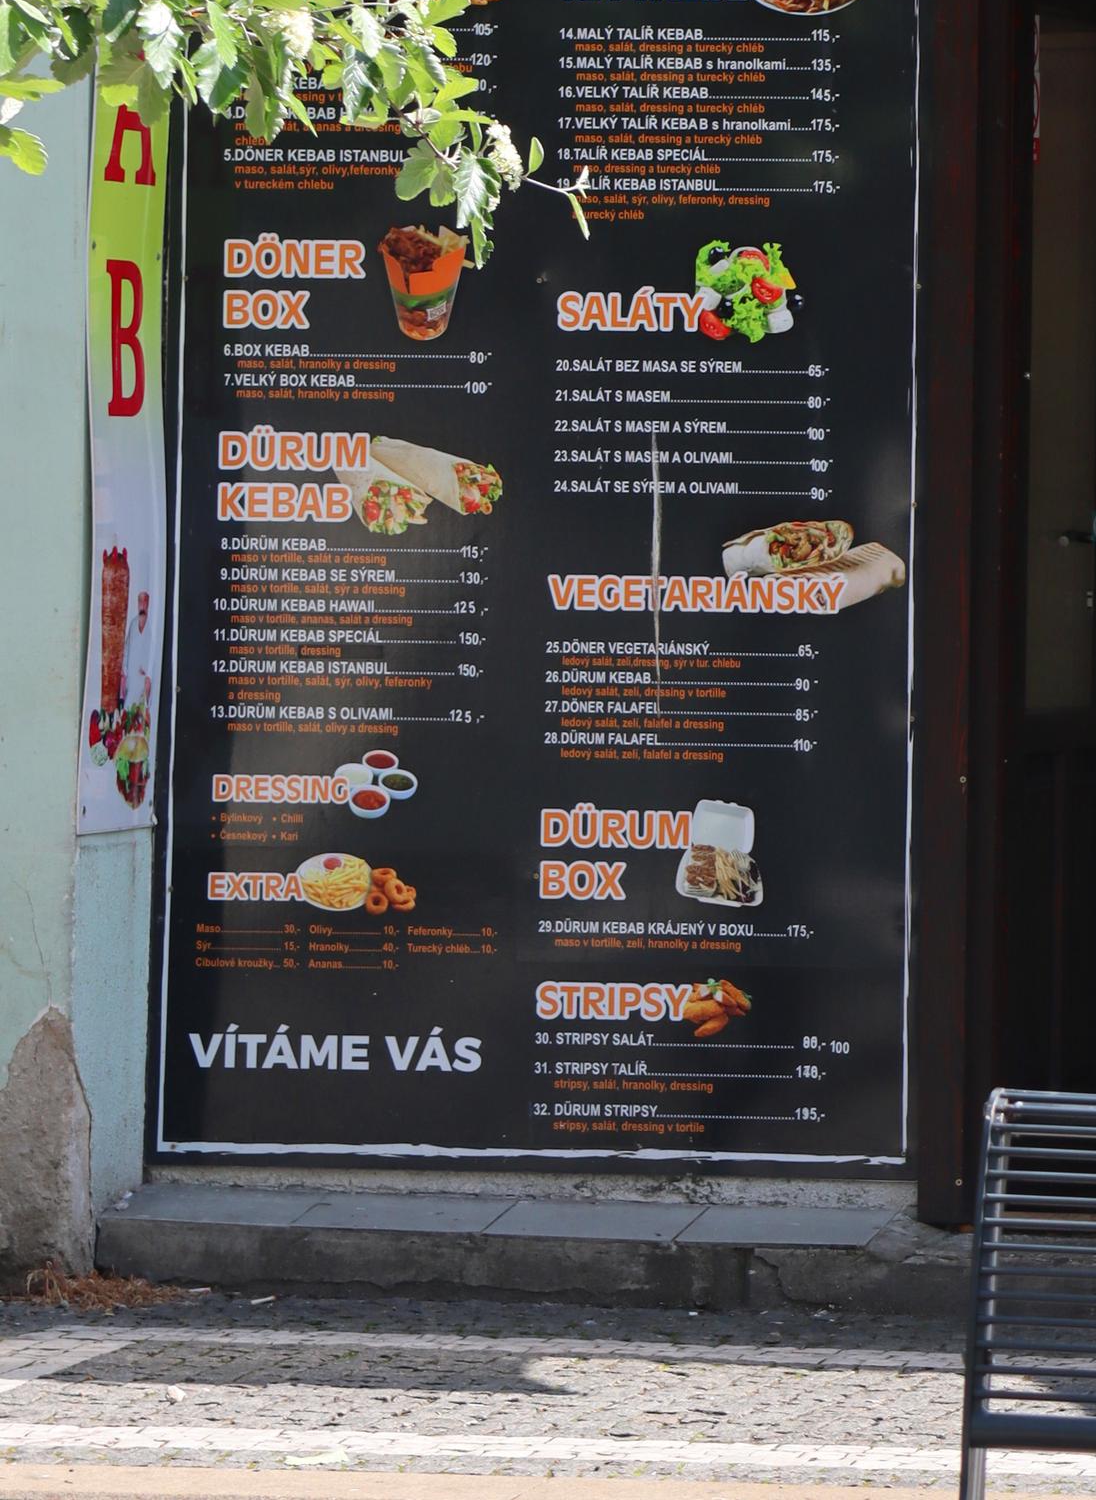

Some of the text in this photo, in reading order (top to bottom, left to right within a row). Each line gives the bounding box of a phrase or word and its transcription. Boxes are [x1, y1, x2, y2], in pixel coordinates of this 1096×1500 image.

[617, 26, 653, 40] TALÍŘ
[658, 29, 703, 40] KEBAB
[639, 43, 684, 55] dressing
[687, 44, 694, 52] a
[616, 55, 653, 69] TALÍŘ
[657, 57, 702, 69] KEBAB
[706, 61, 713, 69] s
[717, 58, 785, 70] hranolkami
[622, 84, 659, 98] TALÍŘ
[663, 87, 710, 98] KEBAB
[621, 115, 657, 129] TALÍŘ
[712, 121, 719, 130] s
[723, 119, 790, 130] hranolkami
[288, 149, 335, 161] KEBAB
[611, 149, 653, 160] KEBAB
[657, 147, 708, 161] SPECIÁL
[244, 179, 294, 189] tureckém
[297, 180, 334, 189] chlebu
[614, 179, 720, 191] KEBAB ISTANBUL
[224, 233, 366, 279] DÖNER
[223, 290, 310, 330] BOX
[558, 286, 706, 332] SALÁTY
[265, 344, 310, 356] KEBAB
[299, 359, 396, 372] hranolky a dressing
[616, 360, 639, 372] BEZ
[643, 361, 677, 372] MASA
[680, 361, 696, 372] SE
[700, 358, 741, 373] SÝREM
[280, 374, 307, 387] BOX
[311, 375, 355, 387] KEBAB
[615, 390, 622, 402] S
[626, 391, 671, 402] MASEM
[615, 420, 622, 432] S
[626, 421, 669, 434] MASEM
[672, 421, 681, 432] A
[684, 419, 726, 433] SÝREM
[218, 425, 370, 472] DÜRUM
[614, 451, 621, 462] S
[625, 450, 669, 464] MASEM
[672, 452, 681, 463] A
[684, 452, 732, 463] OLIVAMI
[614, 481, 629, 492] SE
[678, 482, 687, 493] A
[690, 482, 738, 494] OLIVAMI
[218, 483, 352, 522] KEBAB
[282, 538, 326, 551] KEBAB
[231, 553, 387, 565] maso v salát a dressing
[282, 569, 326, 581] KEBAB
[330, 569, 346, 581] SE
[350, 567, 395, 582] SÝREM
[548, 572, 846, 614] VEGETARIÁNSKÝ
[281, 599, 326, 612] KEBAB
[330, 600, 376, 612] HAWAII
[281, 630, 325, 642] KEBAB
[329, 628, 383, 643] SPECIÁL
[608, 640, 710, 656] VEGETARIÁNSKÝ
[280, 661, 324, 673] KEBAB
[328, 661, 391, 674] ISTANBUL
[228, 676, 256, 685] maso
[384, 677, 432, 687] feferonky
[609, 672, 651, 684] KEBAB
[236, 690, 281, 703] dressing
[280, 706, 324, 719] KEBAB
[328, 707, 336, 719] S
[340, 707, 392, 720] OLIVAMI
[608, 702, 660, 714] FALAFEL
[608, 733, 662, 745] FALAFEL
[643, 750, 672, 759] falafel
[682, 750, 724, 763] dressing
[212, 774, 350, 804] DRESSING
[540, 802, 692, 850] DÜRUM
[208, 872, 304, 901] EXTRA
[540, 860, 626, 900] BOX
[196, 924, 220, 932] Maso
[309, 924, 334, 935] Olivy
[406, 926, 454, 938] Feferonky
[603, 922, 644, 934] KEBAB
[648, 920, 704, 935] KRÁJENÝ
[708, 924, 716, 935] V
[720, 924, 753, 936] BOXU
[196, 940, 211, 950] Sýr
[308, 942, 350, 952] Hranolky
[407, 943, 443, 953] Turecký
[308, 959, 344, 969] Ananas
[536, 980, 693, 1022] STRIPSY
[189, 1024, 481, 1072] VÍTÁME VÁS
[536, 1032, 552, 1044] 30.
[556, 1033, 609, 1045] STRIPSY
[613, 1031, 654, 1046] SALÁT
[830, 1041, 849, 1054] 100
[535, 1061, 647, 1075] 31. STRIPSY TALÍŘ
[534, 1103, 550, 1115] 32.
[604, 1104, 658, 1117] STRIPSY
